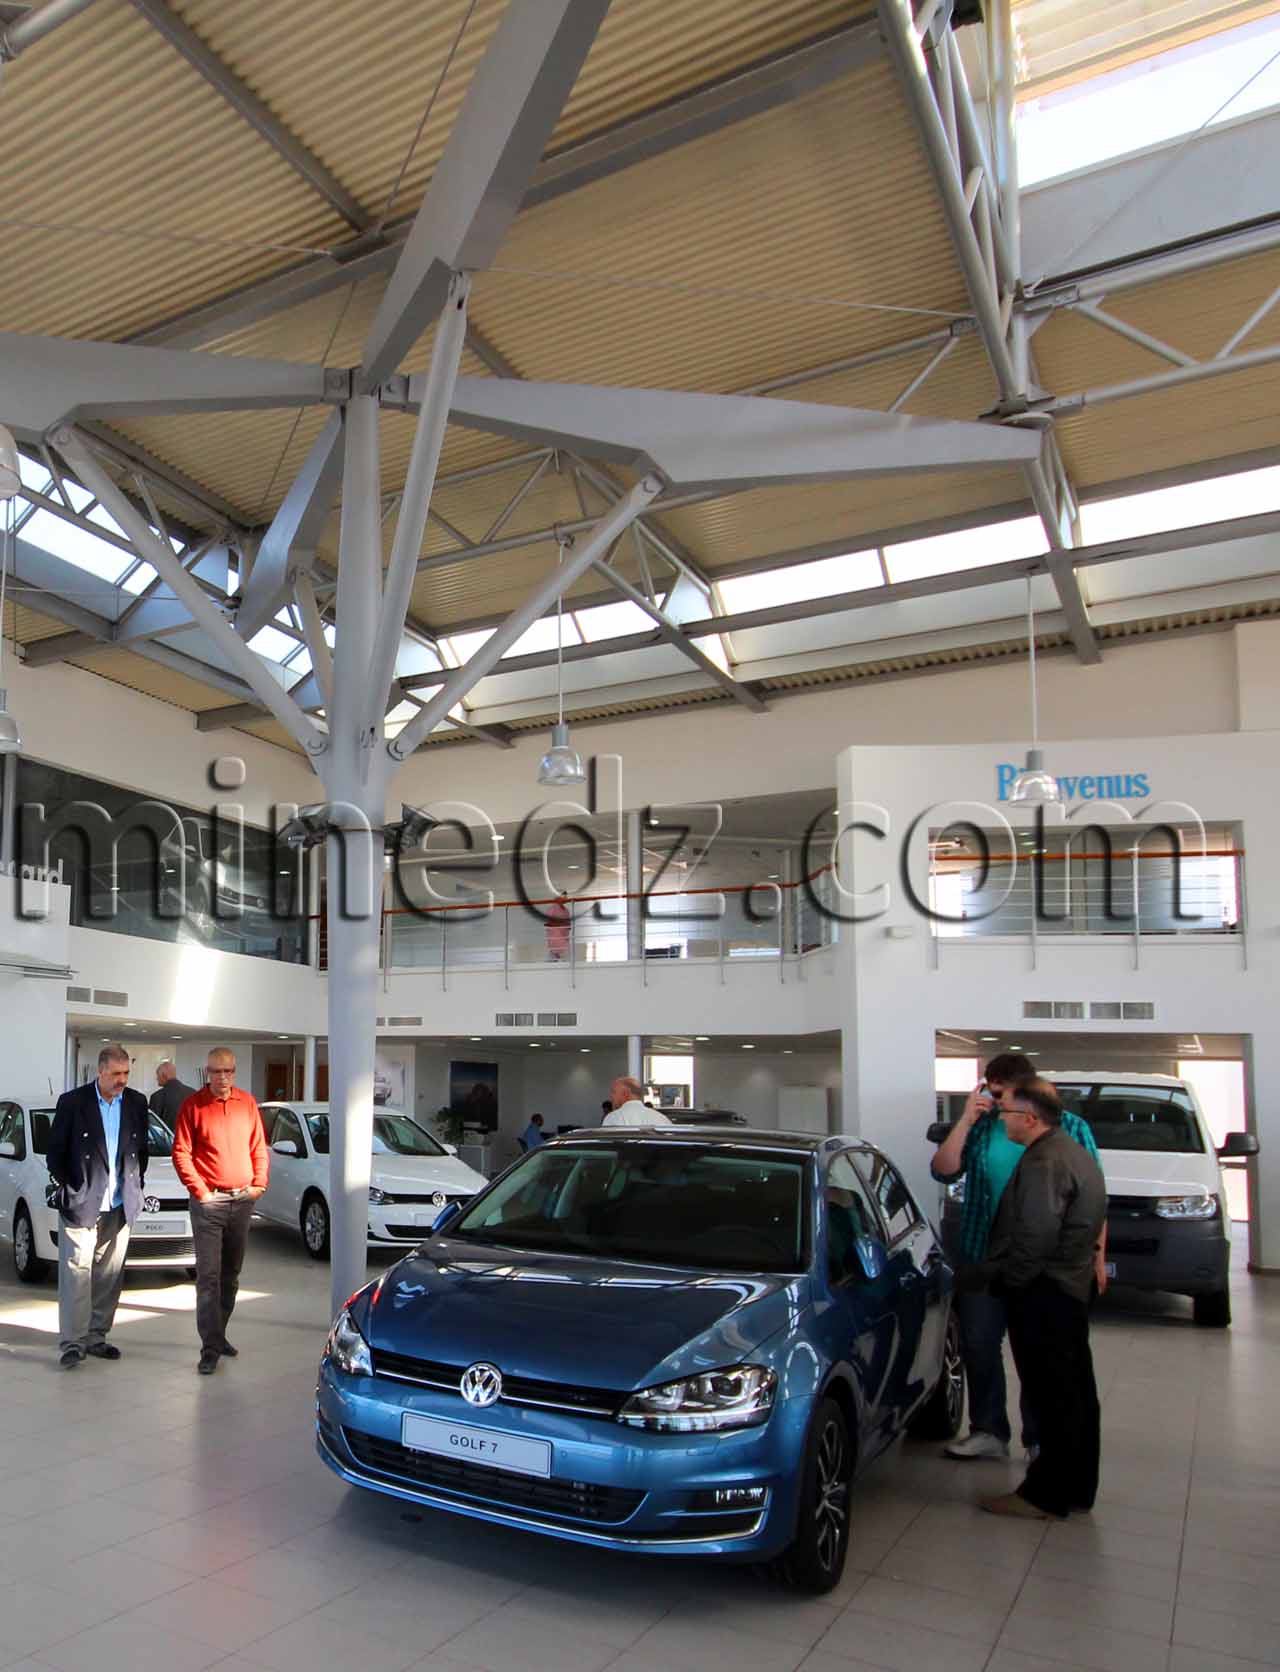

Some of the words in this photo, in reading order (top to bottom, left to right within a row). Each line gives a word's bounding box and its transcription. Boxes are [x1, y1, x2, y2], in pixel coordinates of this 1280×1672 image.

[995, 763, 1151, 801] Bvenus
[449, 1434, 488, 1451] GOLF
[491, 1443, 499, 1453] 7
